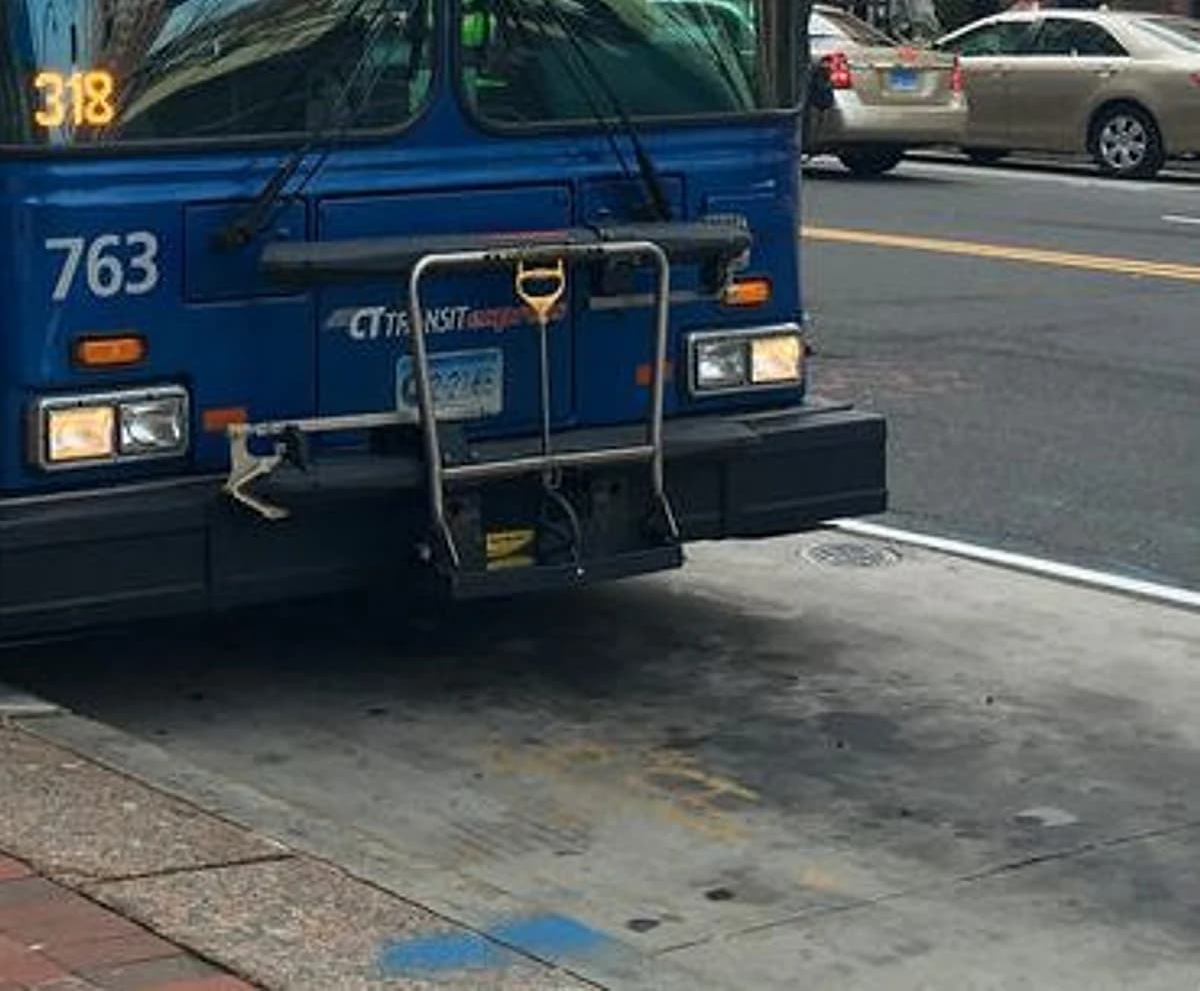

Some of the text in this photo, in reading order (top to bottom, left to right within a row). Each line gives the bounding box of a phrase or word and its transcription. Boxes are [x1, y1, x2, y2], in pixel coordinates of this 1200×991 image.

[33, 70, 115, 128] 318
[44, 230, 160, 301] 763
[384, 306, 469, 338] TRNSIT
